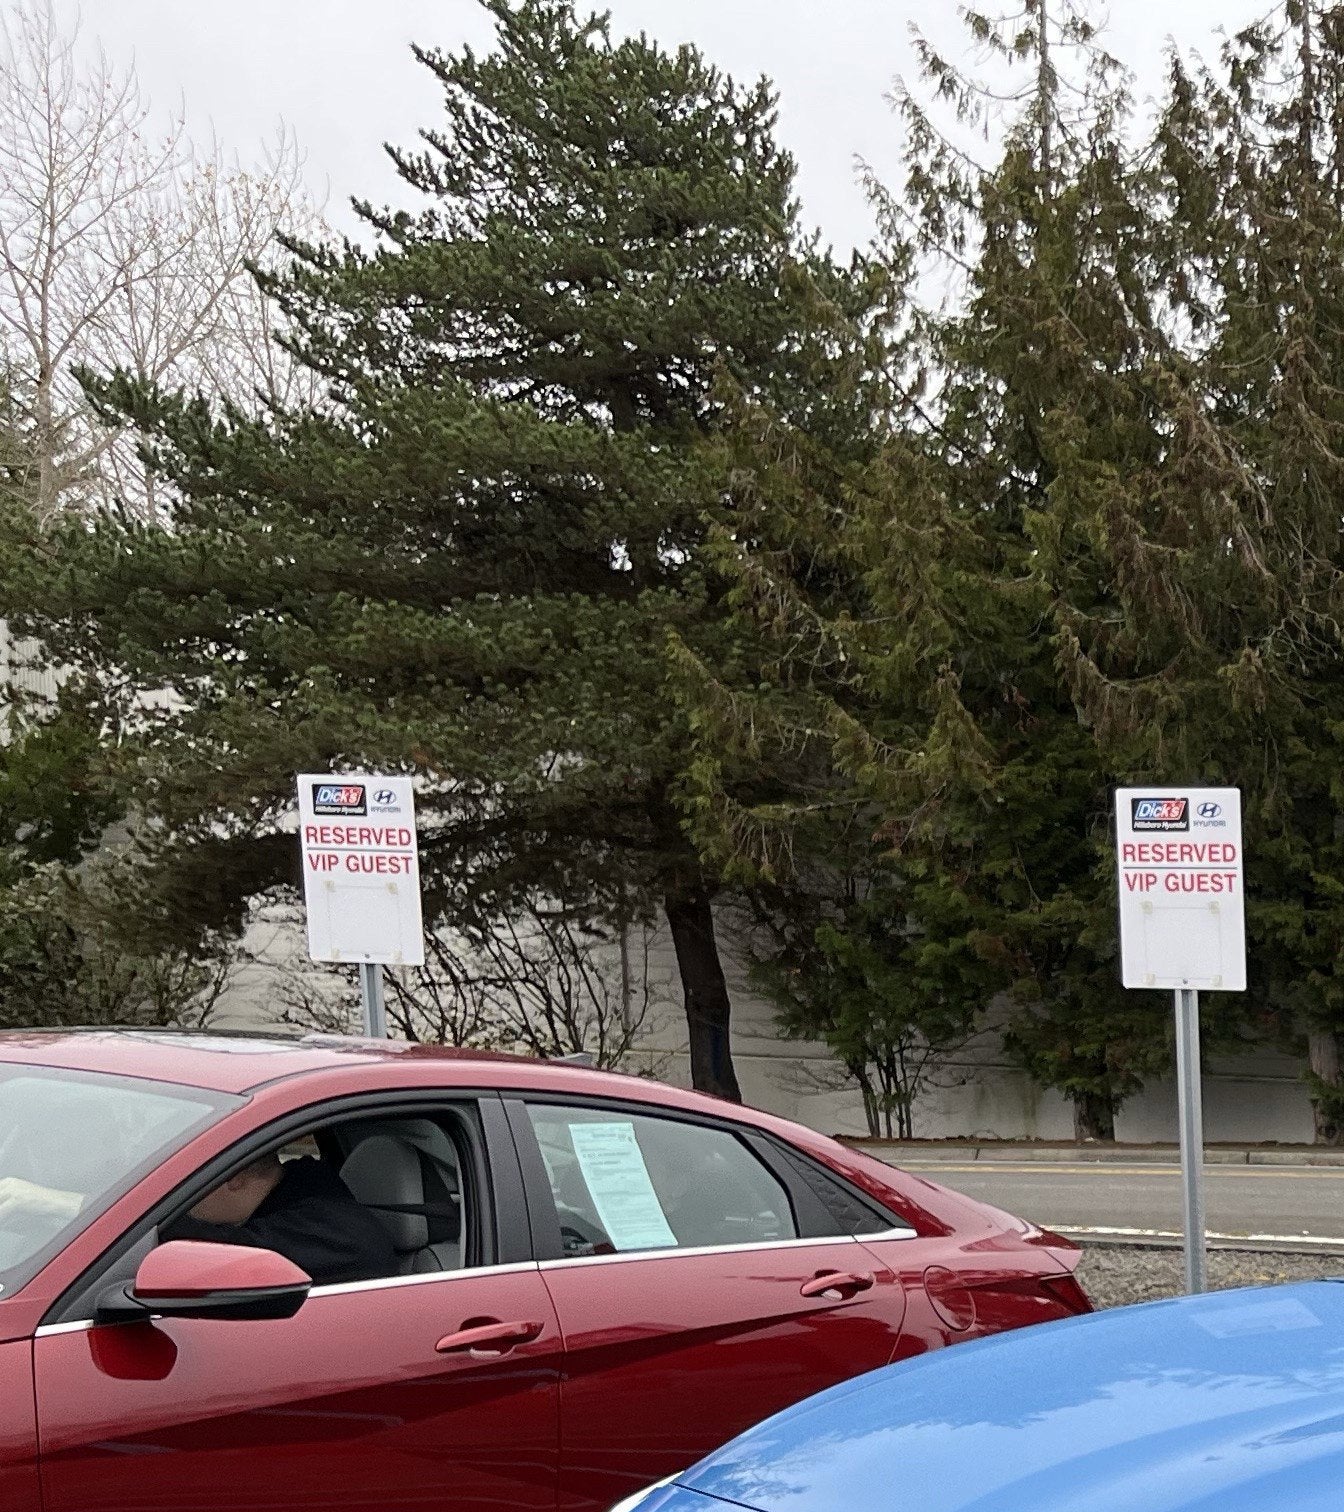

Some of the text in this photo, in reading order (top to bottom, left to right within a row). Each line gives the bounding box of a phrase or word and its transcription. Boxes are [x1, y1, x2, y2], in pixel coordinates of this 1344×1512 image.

[306, 826, 412, 847] RESERVED
[1123, 843, 1237, 864] RESERVED
[308, 854, 413, 875] VIP GUEST
[1124, 872, 1238, 893] VIP GUEST
